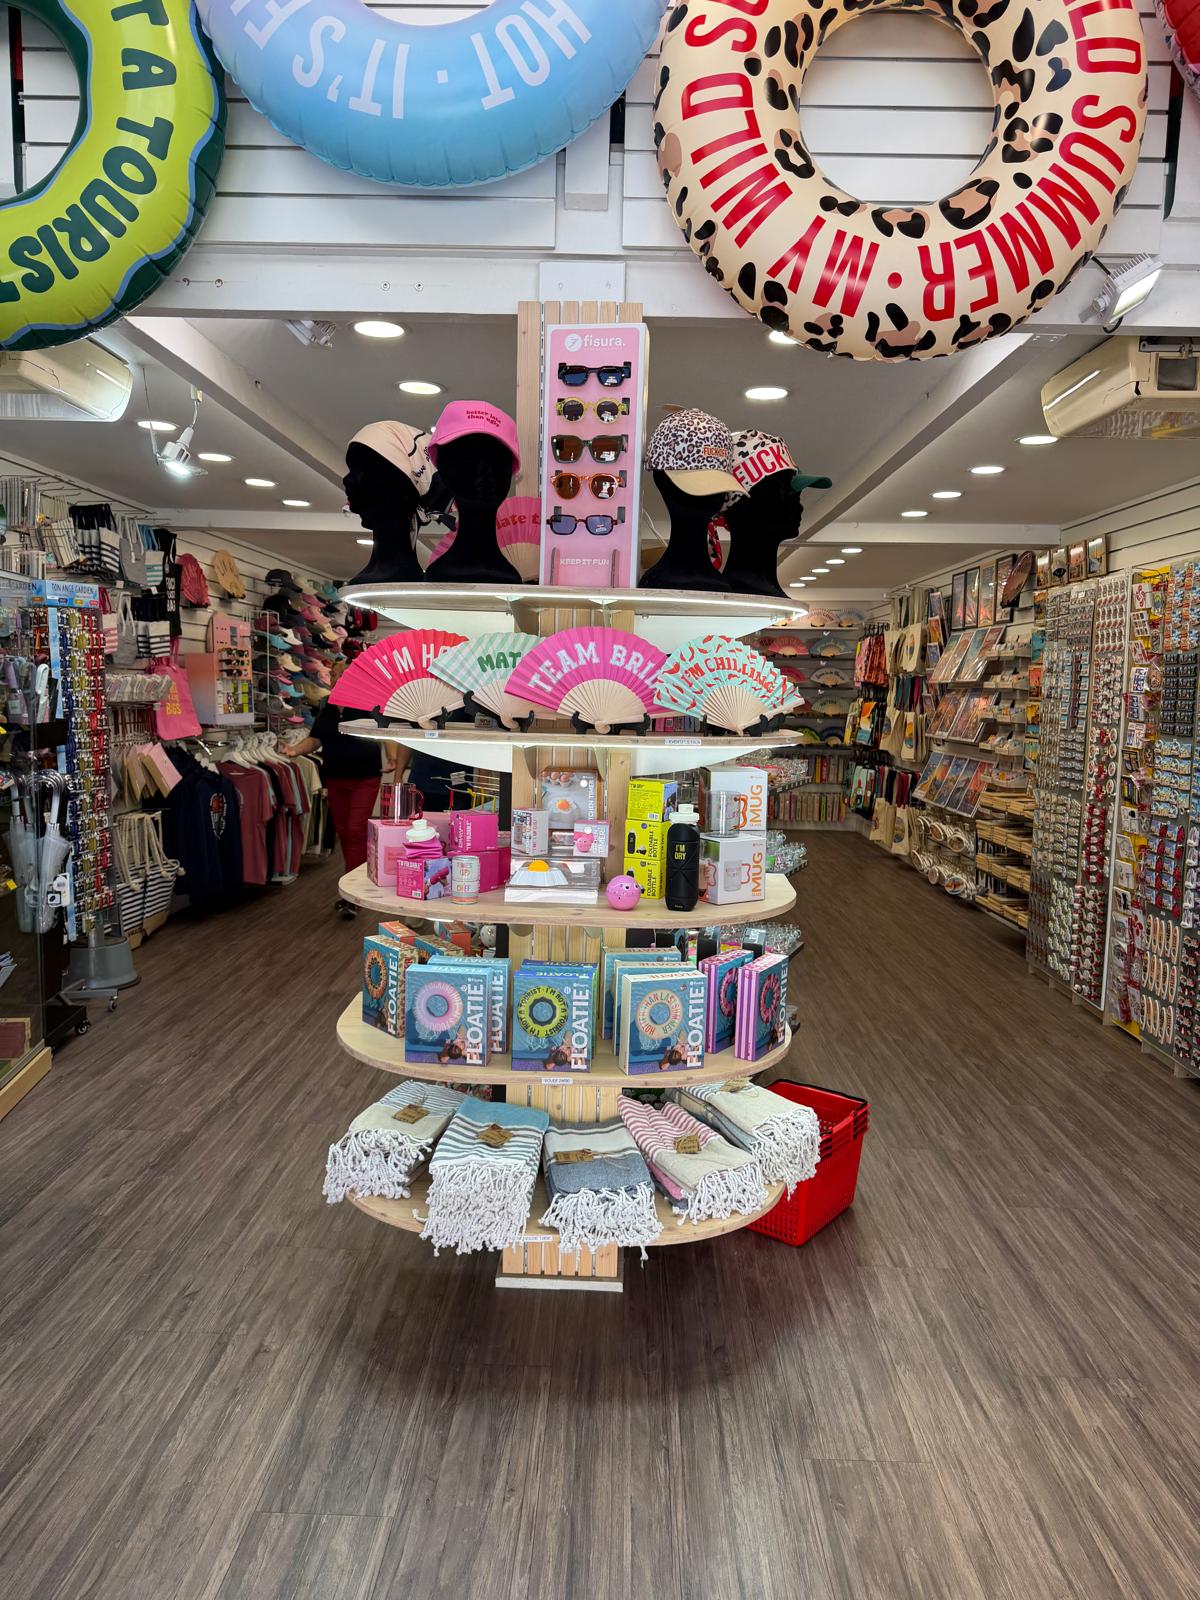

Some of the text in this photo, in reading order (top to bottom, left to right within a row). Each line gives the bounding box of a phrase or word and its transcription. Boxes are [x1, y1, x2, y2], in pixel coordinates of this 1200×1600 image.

[292, 15, 410, 119] IT'S
[470, 0, 592, 110] HOT
[681, 72, 793, 249] WILD
[917, 95, 1136, 322] SUMMER
[766, 215, 880, 317] MY
[374, 646, 415, 679] I'M
[528, 641, 599, 692] TEAM
[681, 656, 775, 694] I'M CHILLING
[750, 784, 763, 824] MUG
[674, 852, 686, 861] DRY
[675, 844, 686, 852] I'M
[751, 852, 763, 892] MUG
[387, 955, 398, 1035] FLOATIE
[466, 984, 485, 1065] FLOATIE
[571, 989, 590, 1070] FLOATIE
[687, 987, 704, 1068] FLOATIE
[778, 966, 788, 1043] FLOATIE
